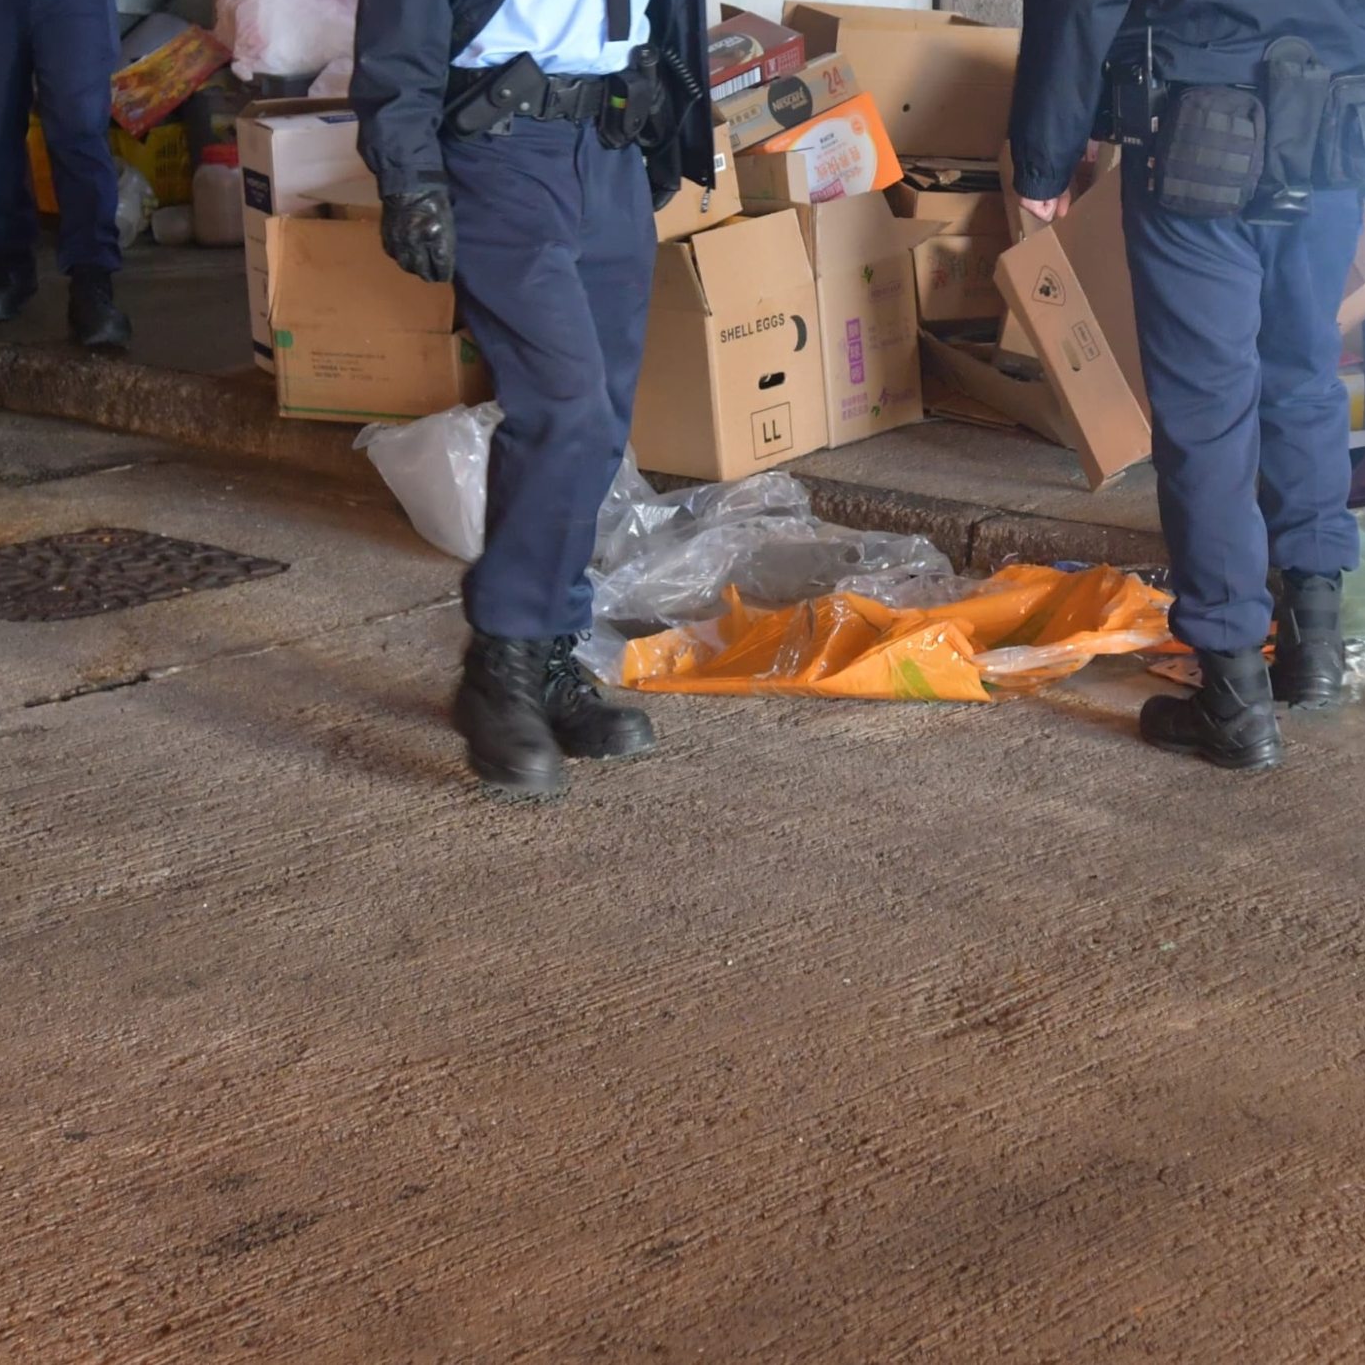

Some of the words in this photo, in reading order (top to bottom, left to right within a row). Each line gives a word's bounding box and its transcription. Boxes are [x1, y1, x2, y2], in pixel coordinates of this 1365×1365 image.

[823, 67, 845, 94] 24
[720, 322, 754, 343] SHELL
[756, 313, 785, 333] EGGS
[762, 419, 782, 443] LL
